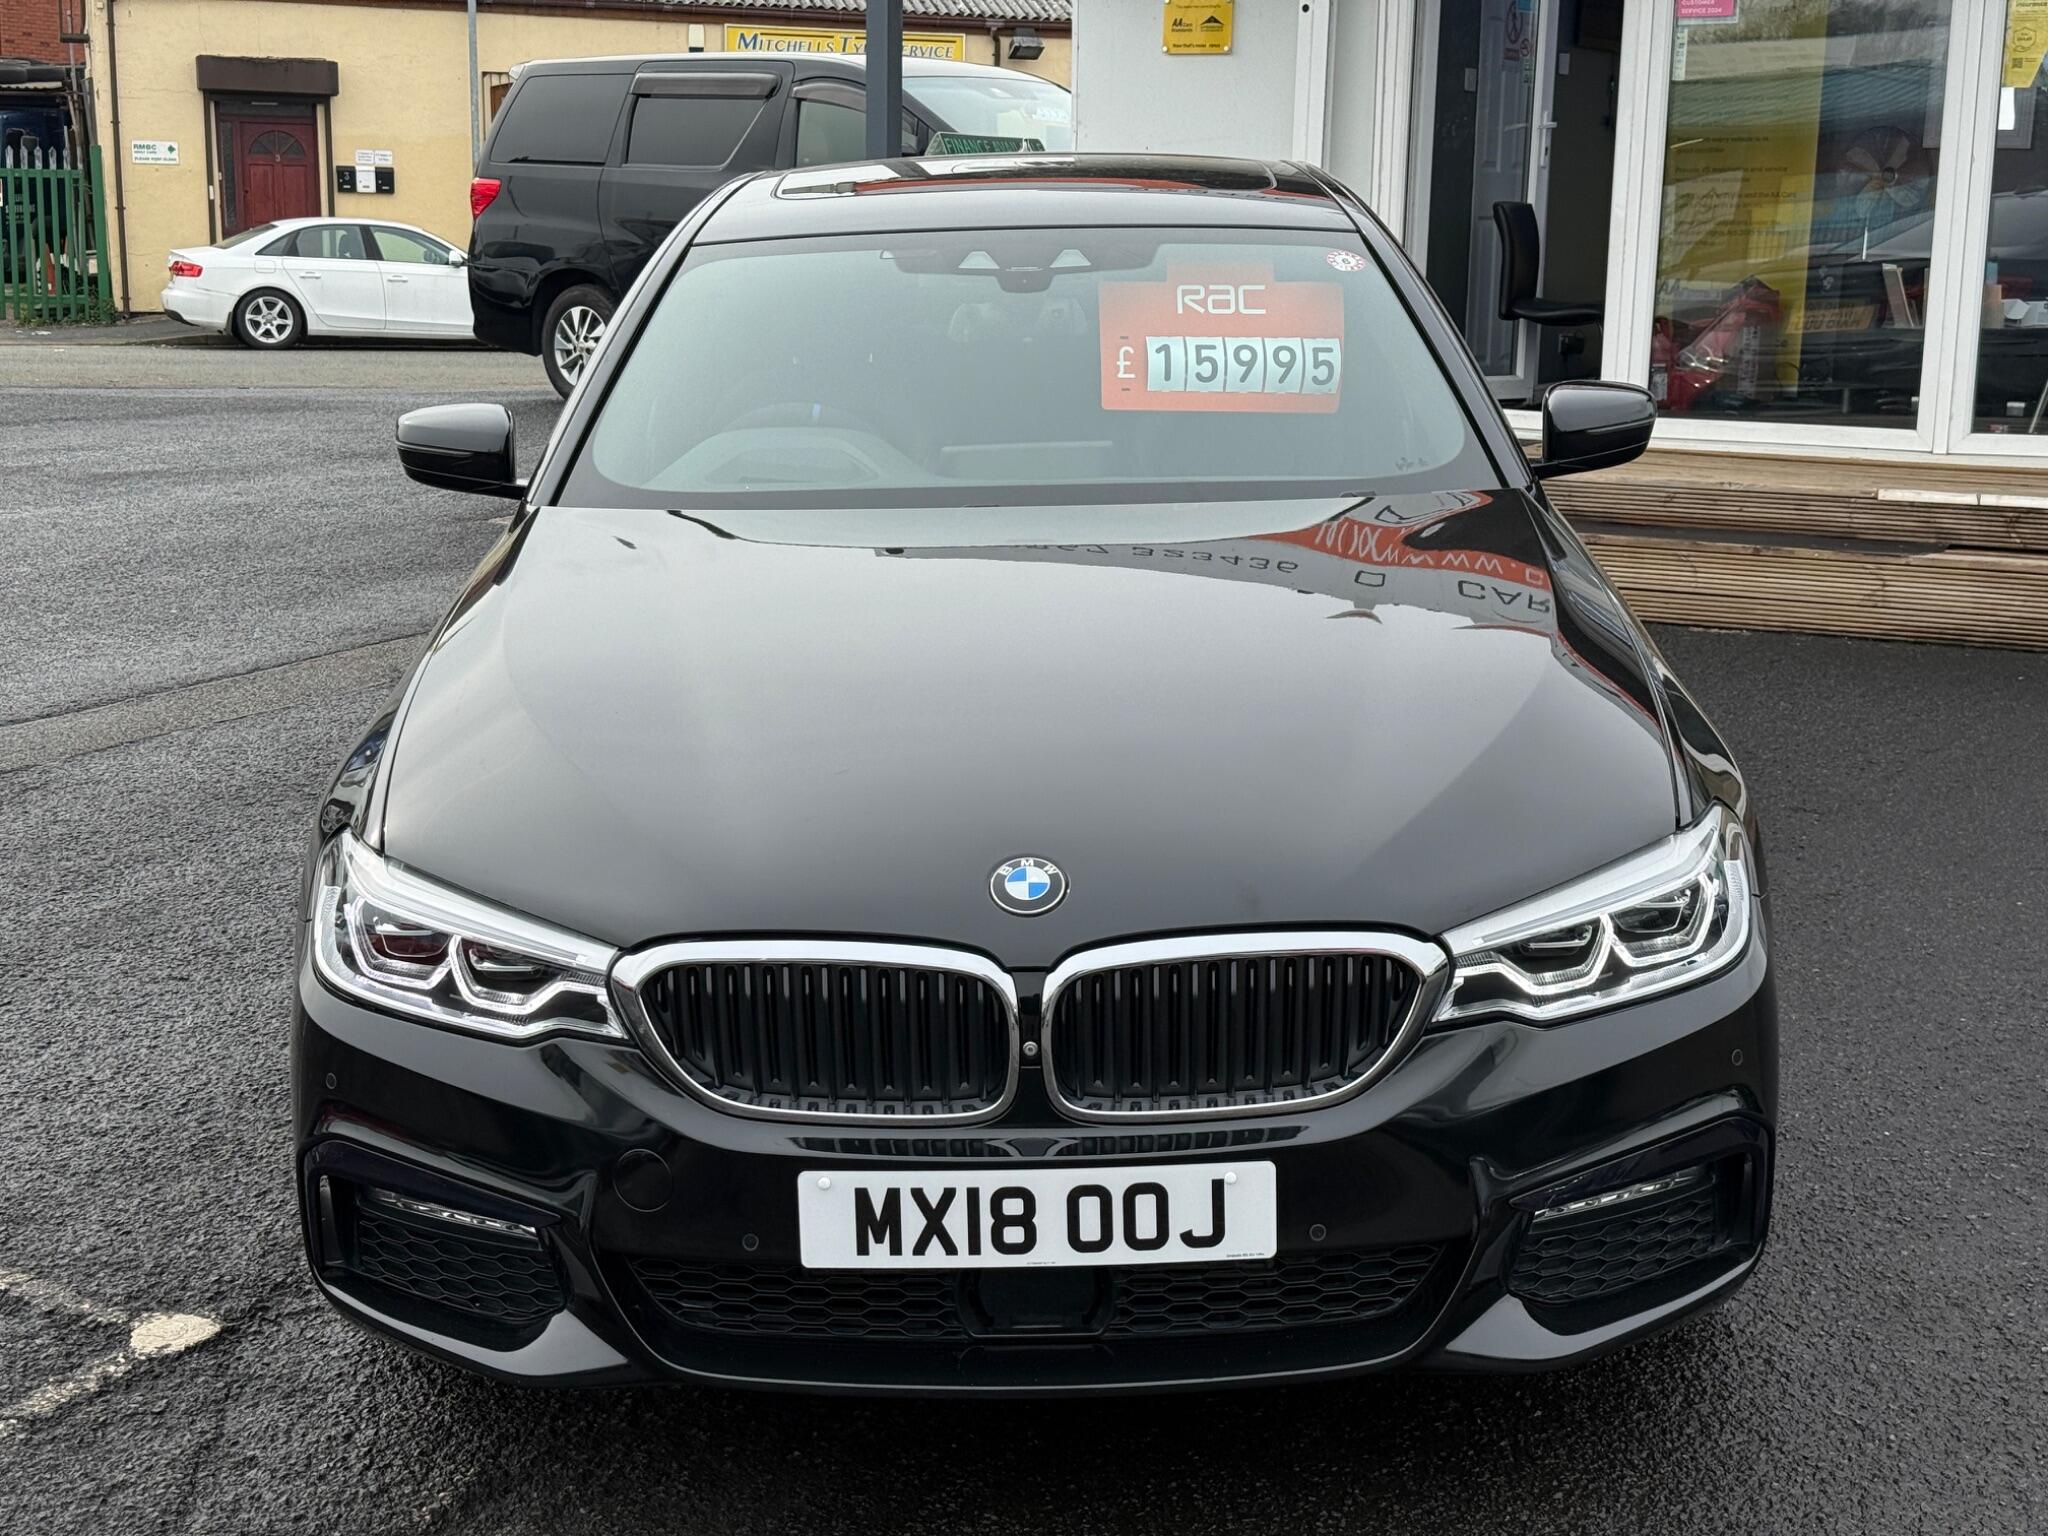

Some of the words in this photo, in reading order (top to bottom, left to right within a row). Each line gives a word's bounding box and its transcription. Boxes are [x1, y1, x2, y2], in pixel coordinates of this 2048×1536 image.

[901, 44, 954, 58] ERVICE
[943, 137, 991, 156] FINANCE
[1116, 345, 1137, 379] £
[1154, 343, 1336, 386] 15995
[997, 858, 1058, 875] BMW
[854, 1186, 1038, 1257] MX18
